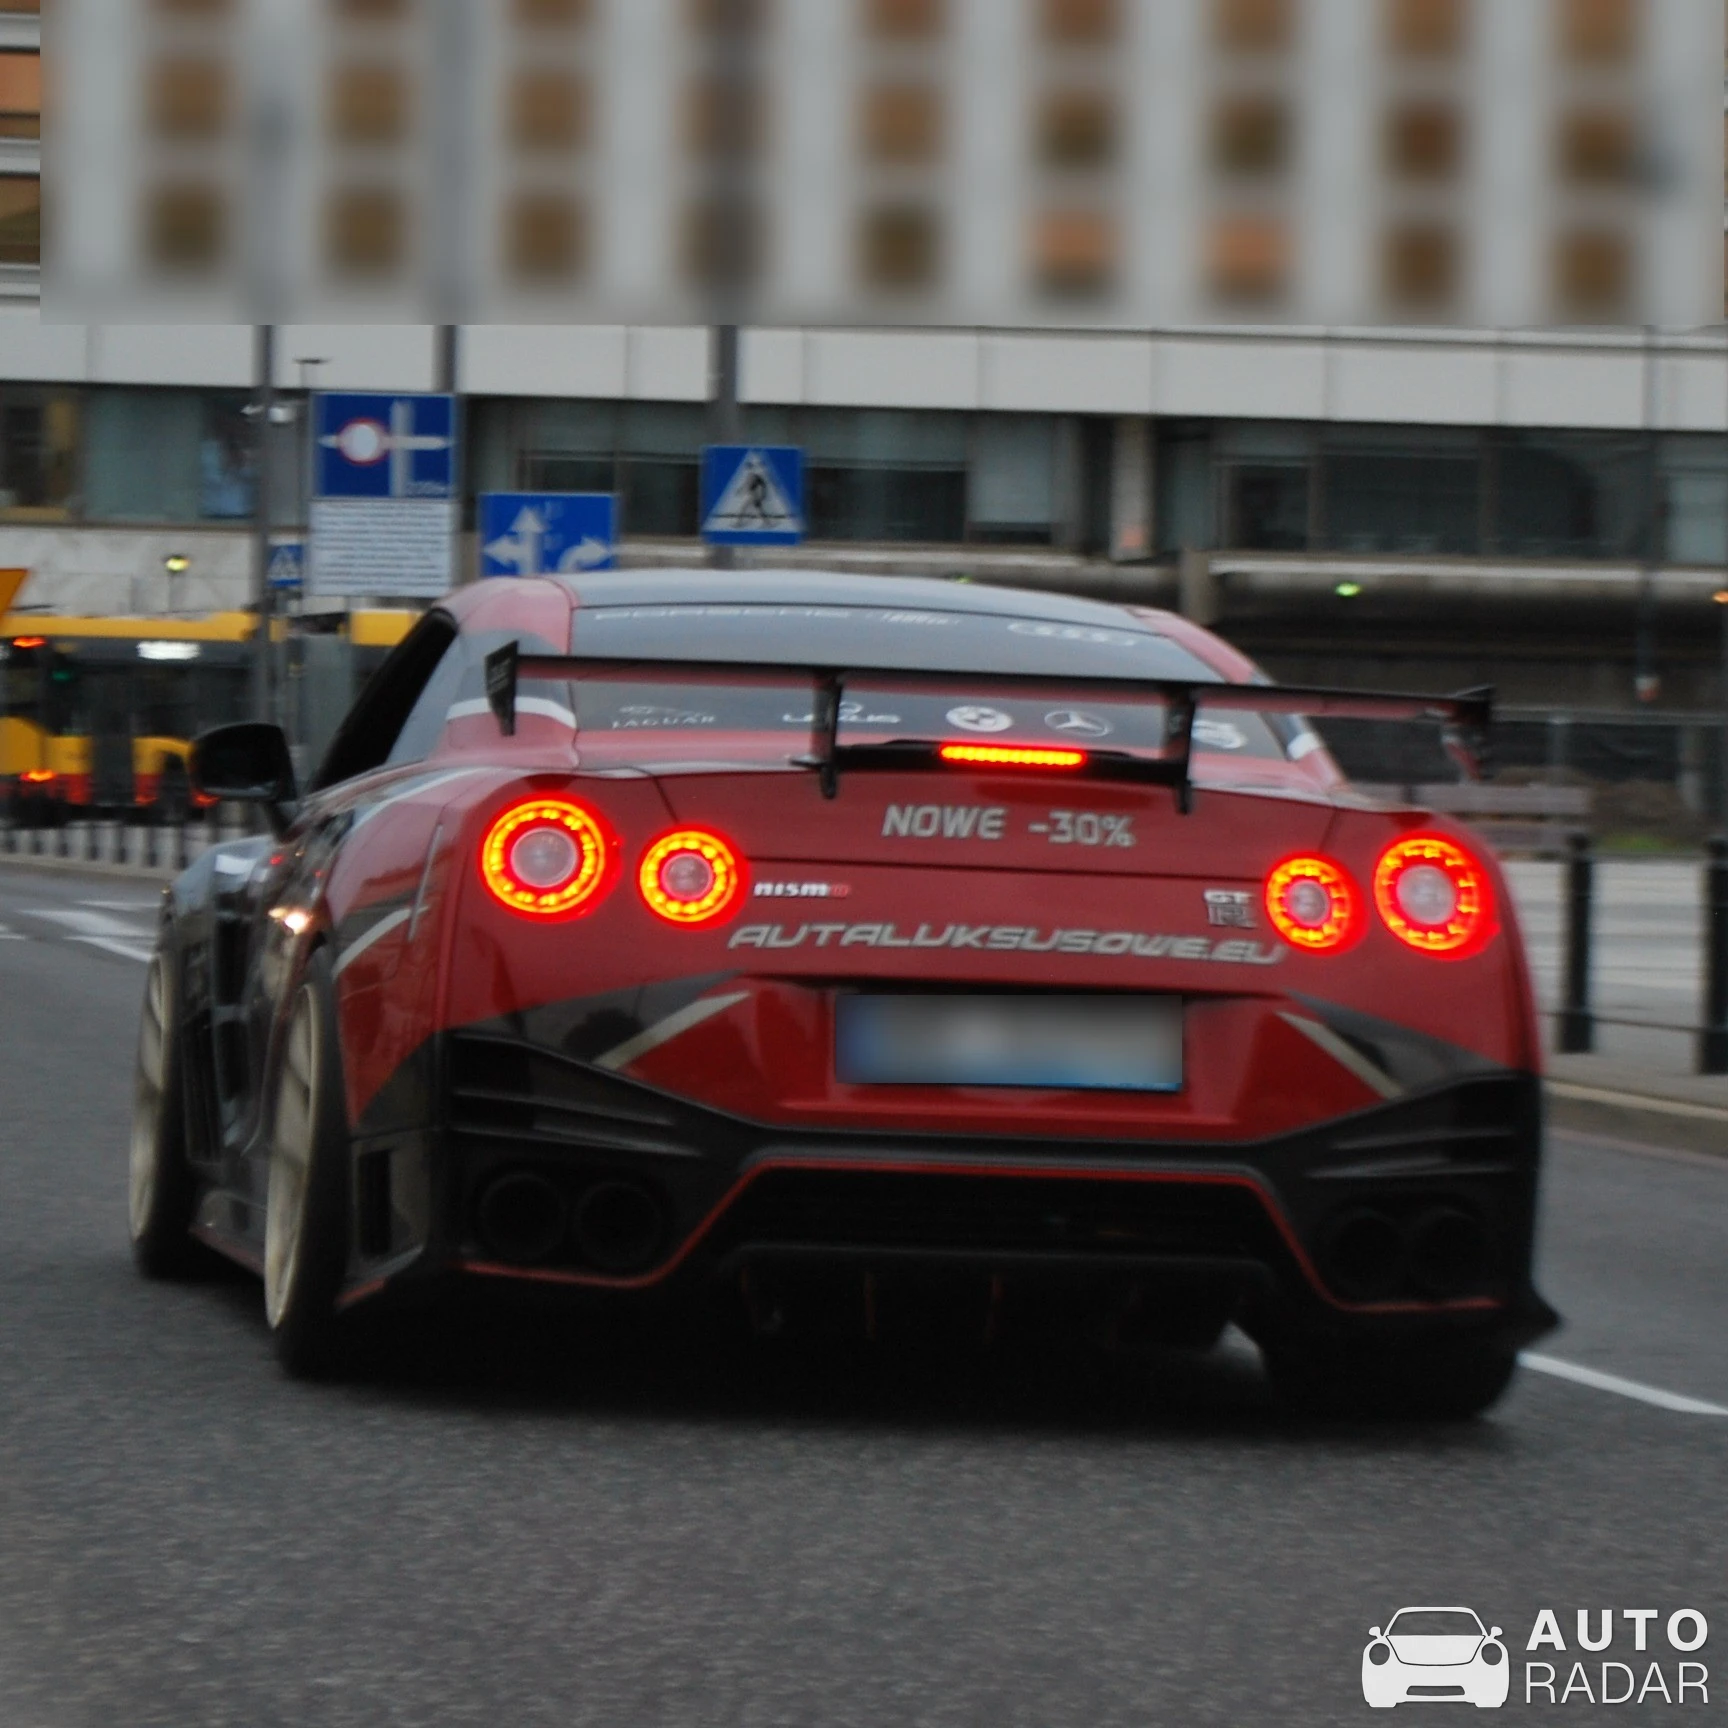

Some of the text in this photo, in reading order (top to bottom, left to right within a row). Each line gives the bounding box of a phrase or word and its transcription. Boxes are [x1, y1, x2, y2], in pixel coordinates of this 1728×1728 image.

[881, 804, 1136, 848] NOWE -30%
[728, 922, 1285, 965] AUTALUKSUSOWE.EU
